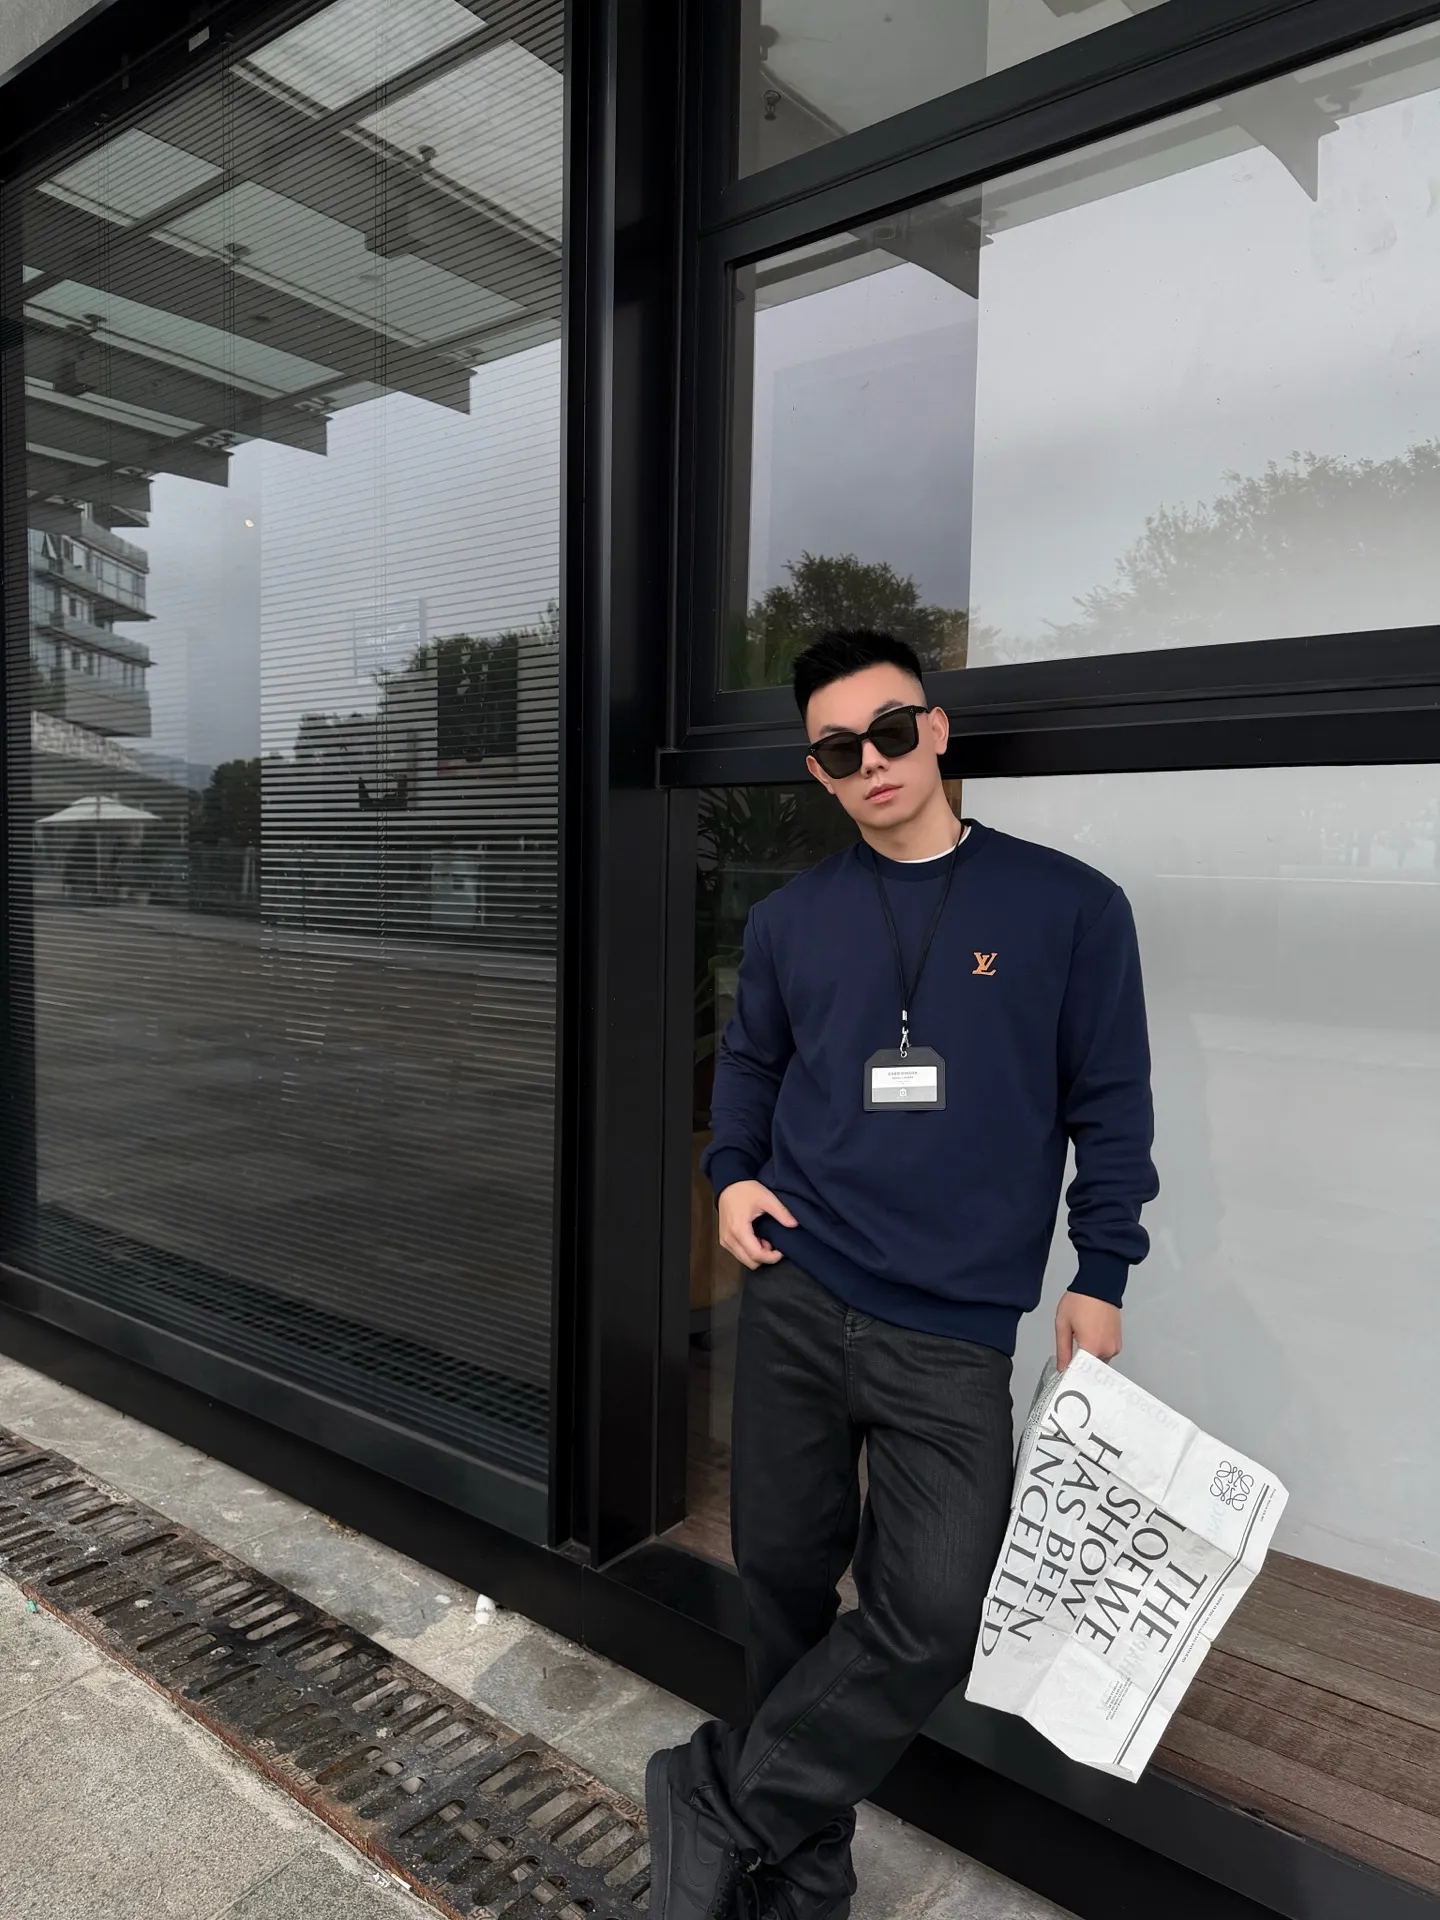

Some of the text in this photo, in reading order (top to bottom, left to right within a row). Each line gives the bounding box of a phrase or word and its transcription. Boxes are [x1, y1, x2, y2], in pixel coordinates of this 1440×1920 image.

[981, 1389, 1091, 1657] CANCELLED
[1007, 1431, 1123, 1642] HAS BEEN
[1060, 1485, 1141, 1621] SHOW
[1075, 1507, 1188, 1655] LOEWE
[1129, 1560, 1208, 1653] THE
